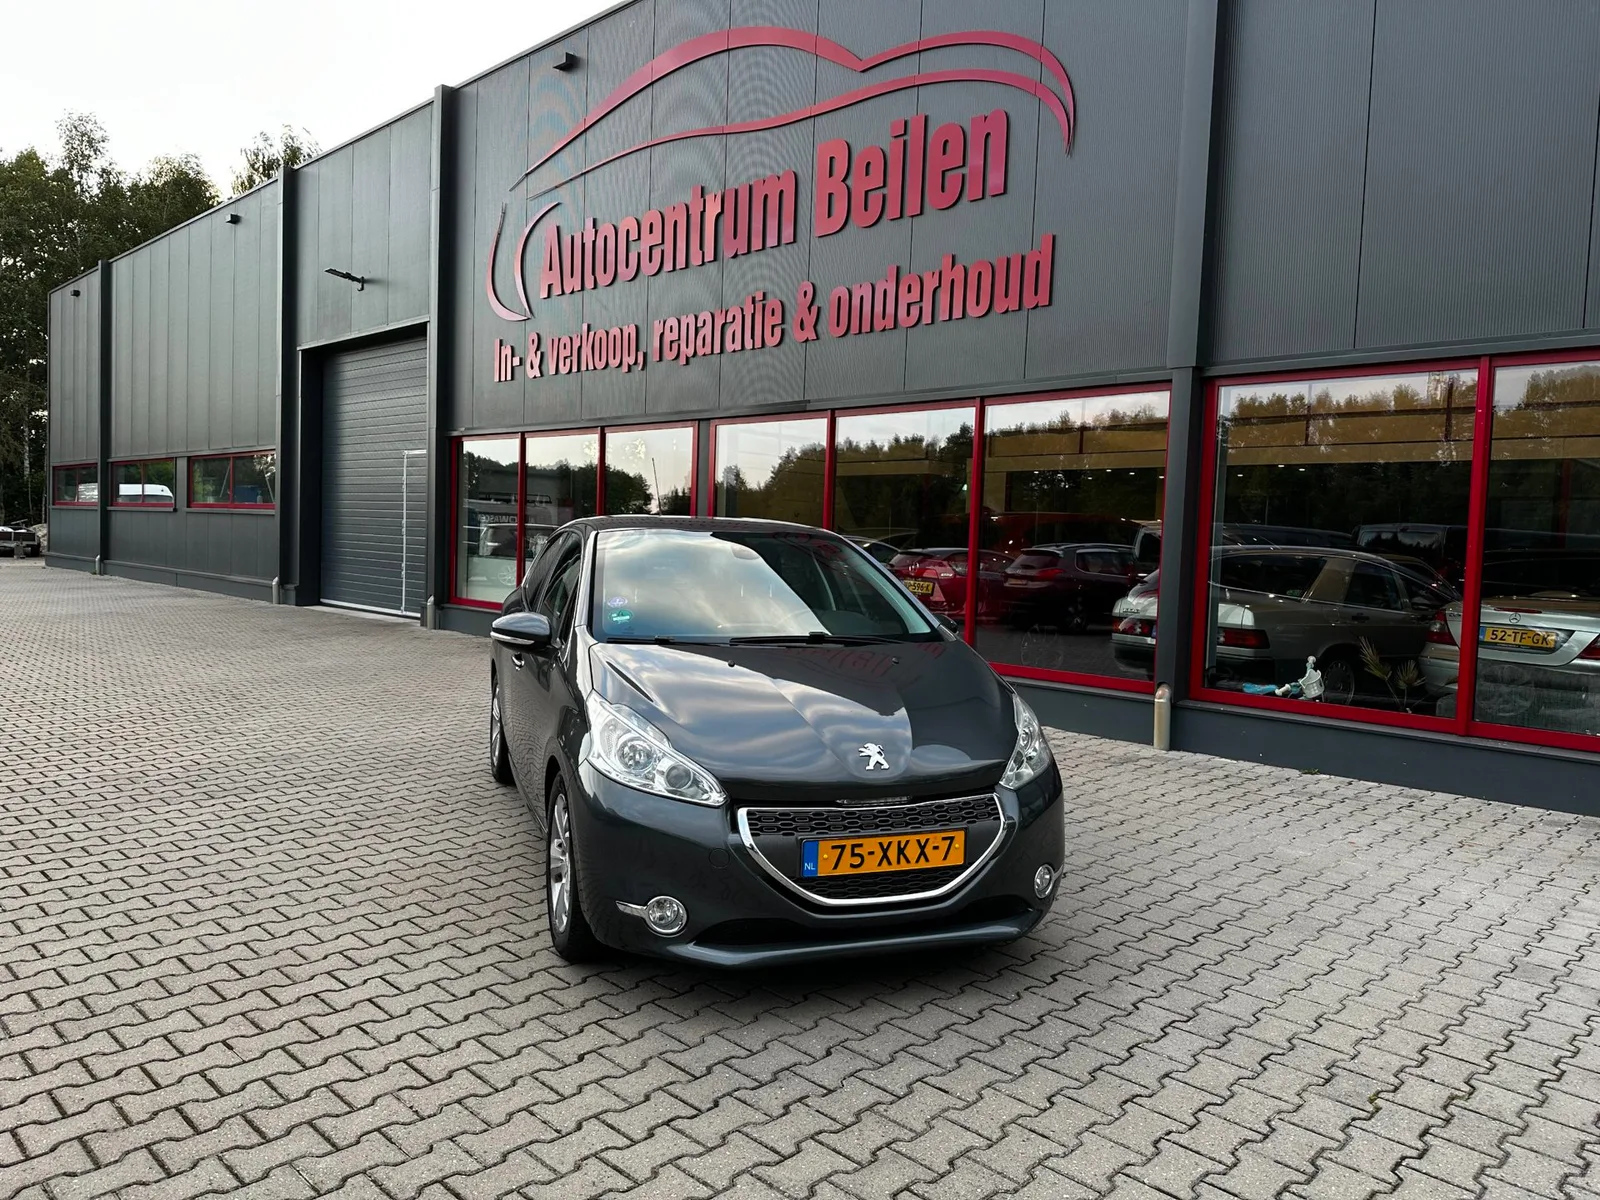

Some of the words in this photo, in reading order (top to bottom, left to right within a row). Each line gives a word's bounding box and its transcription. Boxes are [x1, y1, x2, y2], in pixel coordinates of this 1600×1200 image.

[540, 169, 797, 299] Autocentrum
[814, 108, 1010, 238] Beilen
[493, 338, 522, 382] In-
[526, 331, 541, 378] &
[548, 322, 646, 375] verkoop,
[652, 290, 784, 366] reparatie
[793, 280, 820, 342] &
[830, 233, 1056, 338] onderhoud
[1490, 629, 1550, 646] 52-TF-GK
[804, 862, 816, 870] NL
[831, 836, 956, 870] 75-XKX-7
